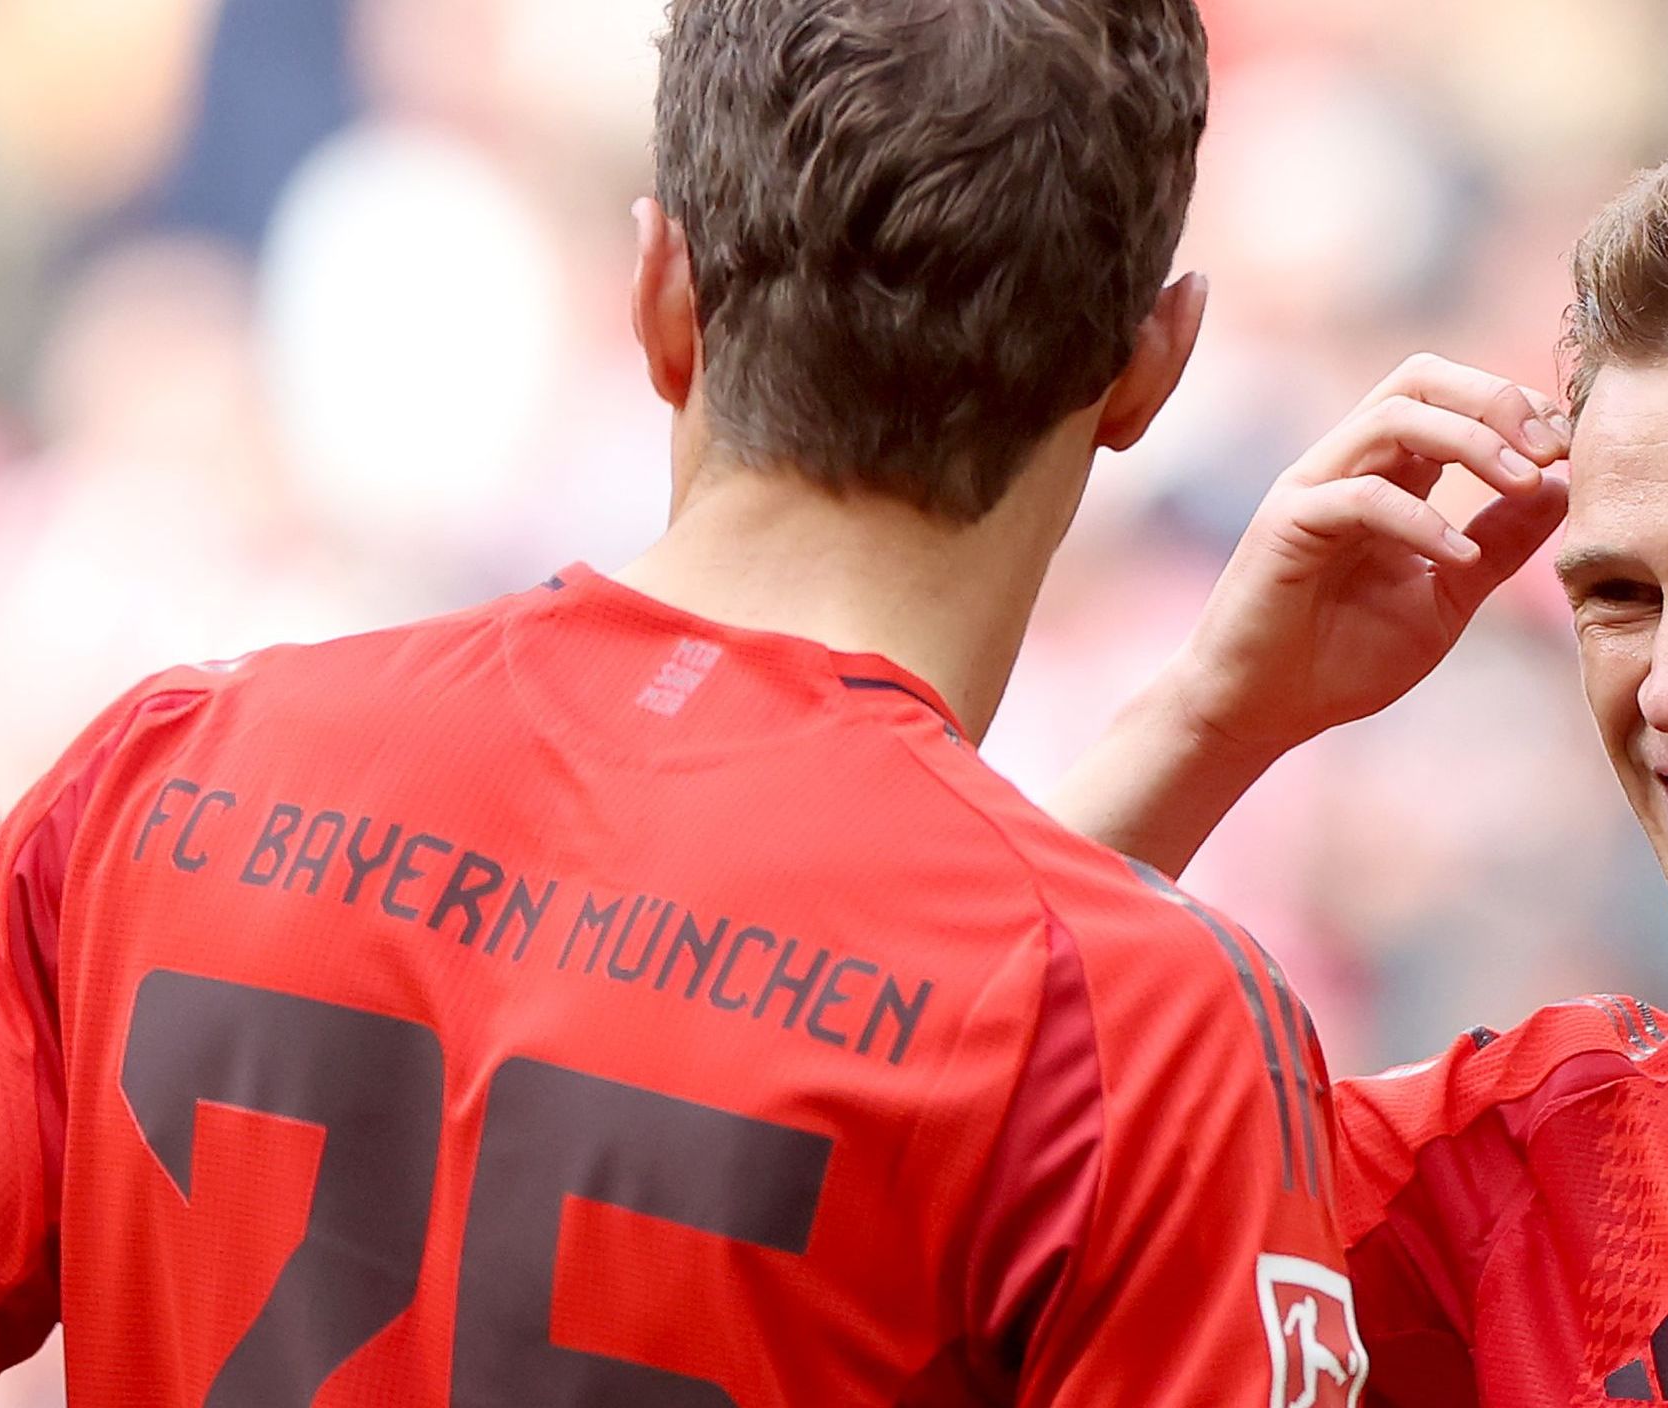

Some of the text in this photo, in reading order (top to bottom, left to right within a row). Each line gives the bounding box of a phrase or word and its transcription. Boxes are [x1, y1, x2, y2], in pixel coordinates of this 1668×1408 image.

[133, 778, 934, 1066] FC BAYERN MÜNCHEN
